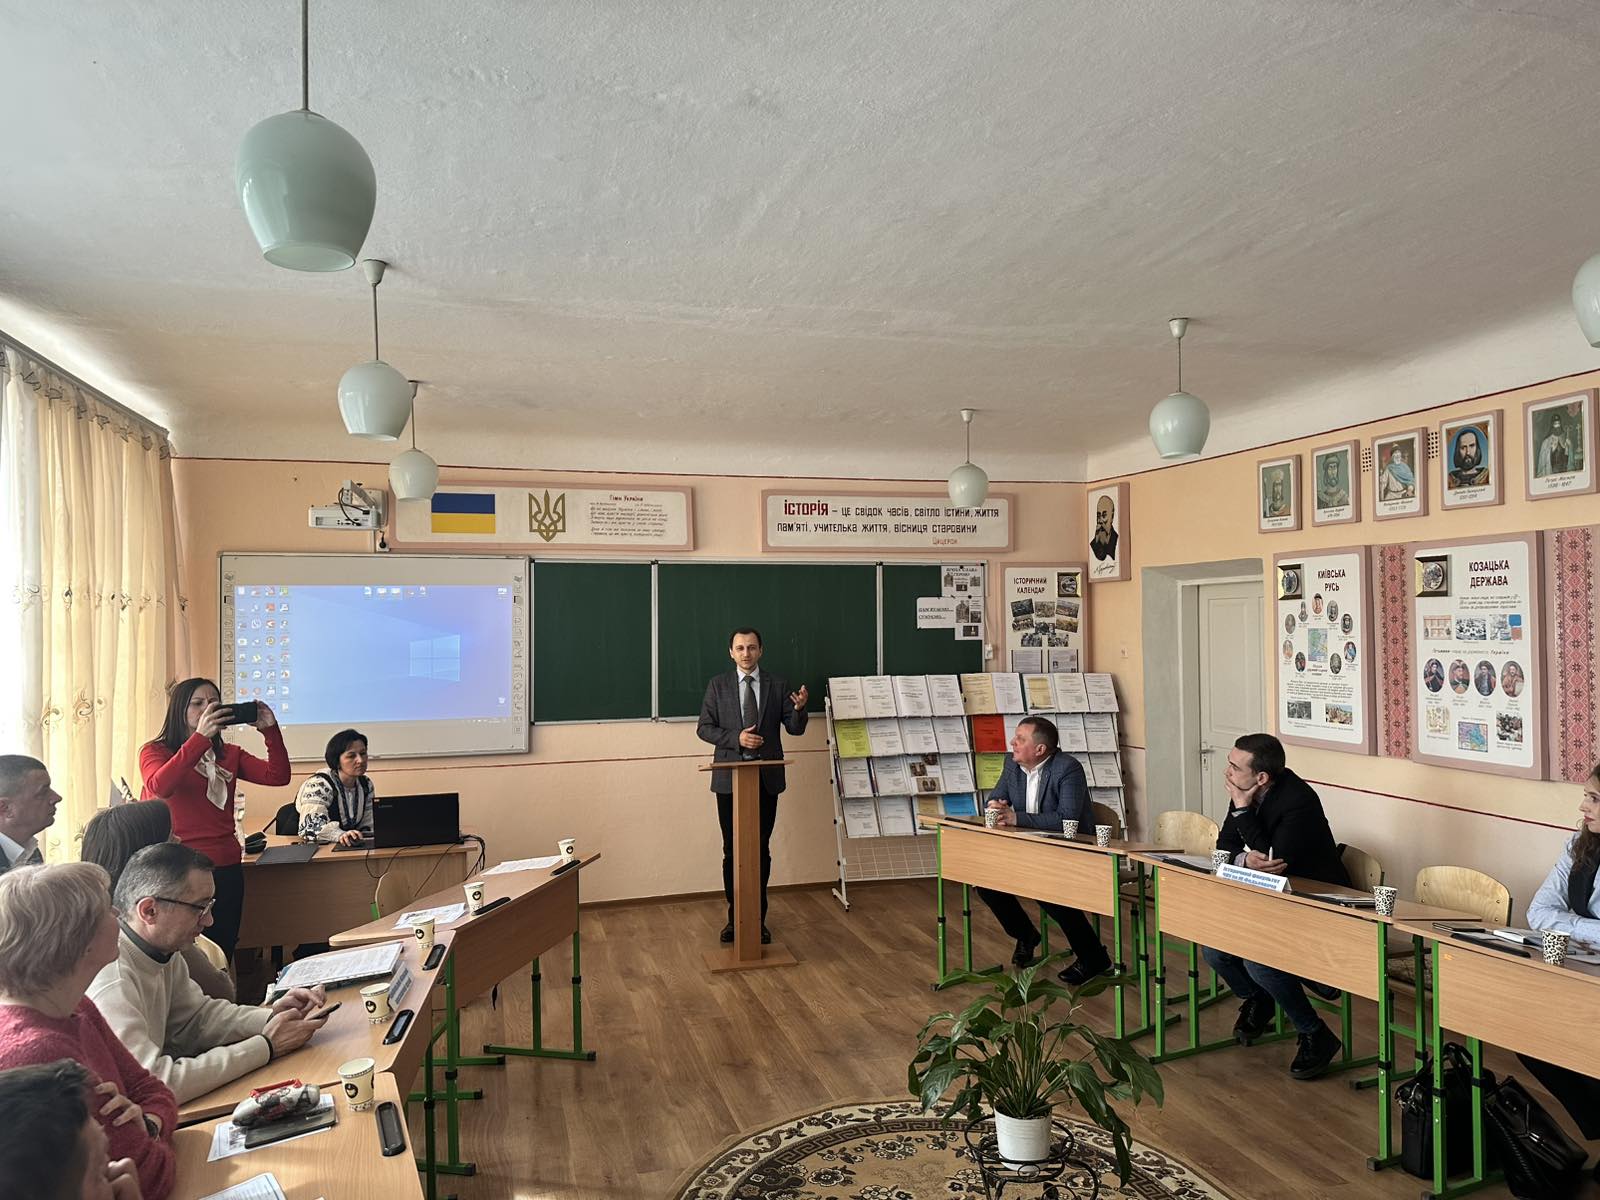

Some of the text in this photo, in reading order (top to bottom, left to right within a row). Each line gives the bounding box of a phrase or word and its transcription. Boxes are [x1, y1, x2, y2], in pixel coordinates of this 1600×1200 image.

[1469, 559, 1510, 572] КОЗАЦЬКА
[1318, 569, 1346, 579] КИЇВСЬКА
[1470, 575, 1508, 588] ДЕРЖАВА
[1324, 583, 1340, 592] РУСЬ
